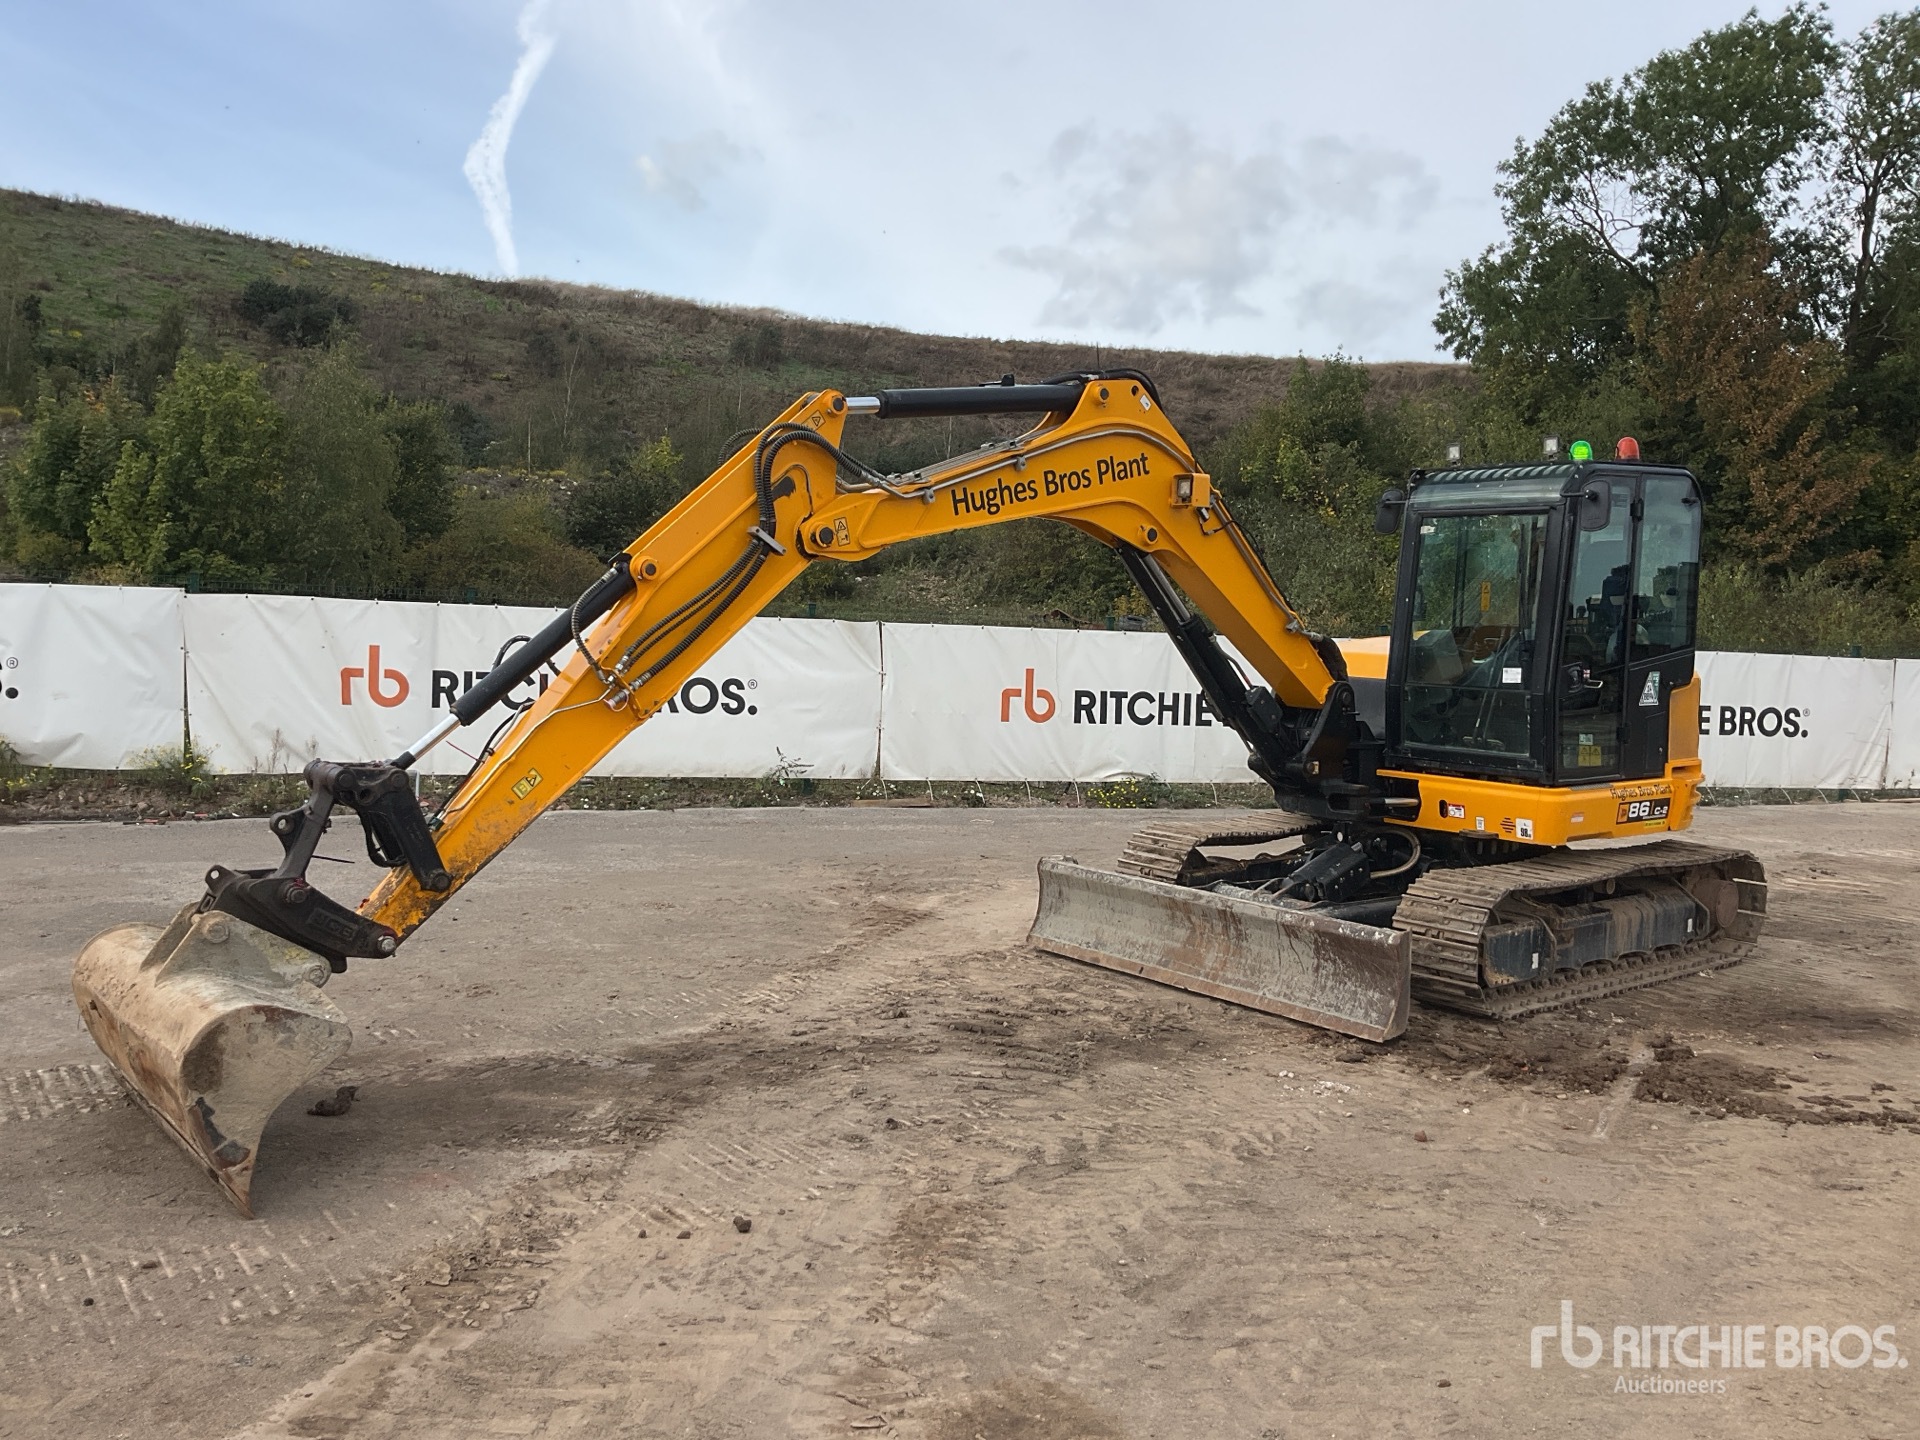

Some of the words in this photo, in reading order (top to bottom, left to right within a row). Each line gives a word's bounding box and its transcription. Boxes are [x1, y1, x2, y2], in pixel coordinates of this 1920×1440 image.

[951, 478, 1038, 516] Hughes
[1044, 467, 1092, 496] Bros
[1096, 452, 1150, 485] Plant
[340, 645, 410, 708] rb
[1000, 668, 1056, 723] rb
[653, 677, 758, 715] OS.
[1718, 705, 1809, 738] BROS.
[1610, 786, 1638, 801] Hughes
[1638, 785, 1654, 797] Bros
[1654, 784, 1673, 796] Plant
[1628, 801, 1651, 818] 86
